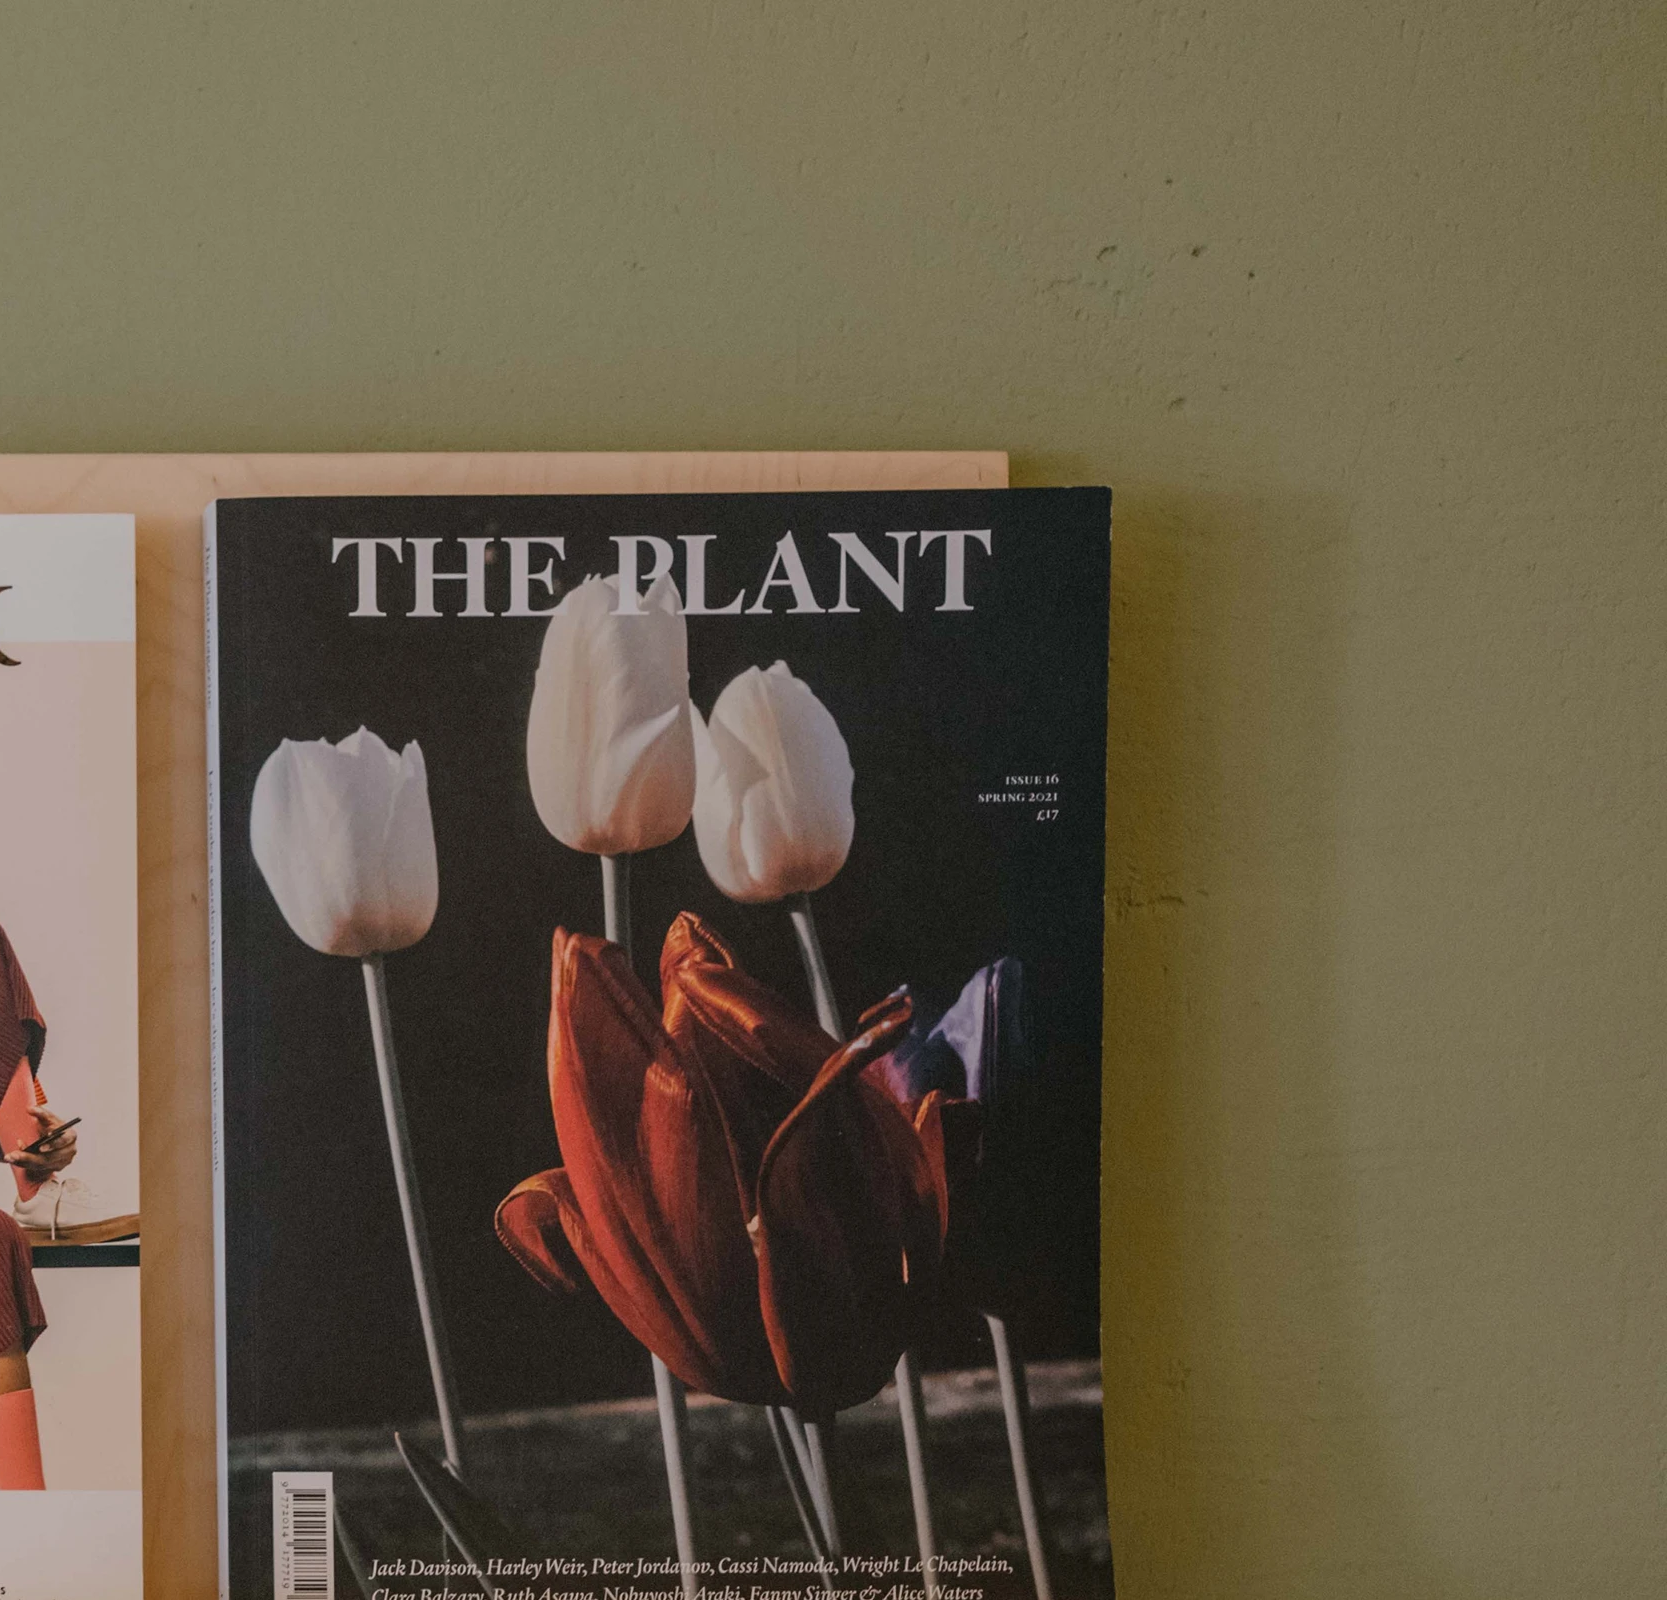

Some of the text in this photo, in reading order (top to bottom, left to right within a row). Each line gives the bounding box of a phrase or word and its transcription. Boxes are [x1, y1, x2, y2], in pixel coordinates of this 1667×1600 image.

[330, 529, 993, 618] THE PLANT
[1005, 773, 1060, 786] ISSUE 16
[978, 792, 1058, 803] SPRING 2021
[1036, 809, 1060, 822] £17
[367, 1555, 1014, 1580] Jack Davison, Harley Weir, Peter Jordanov, Cassi Namoda, Wright Le Chapelain,
